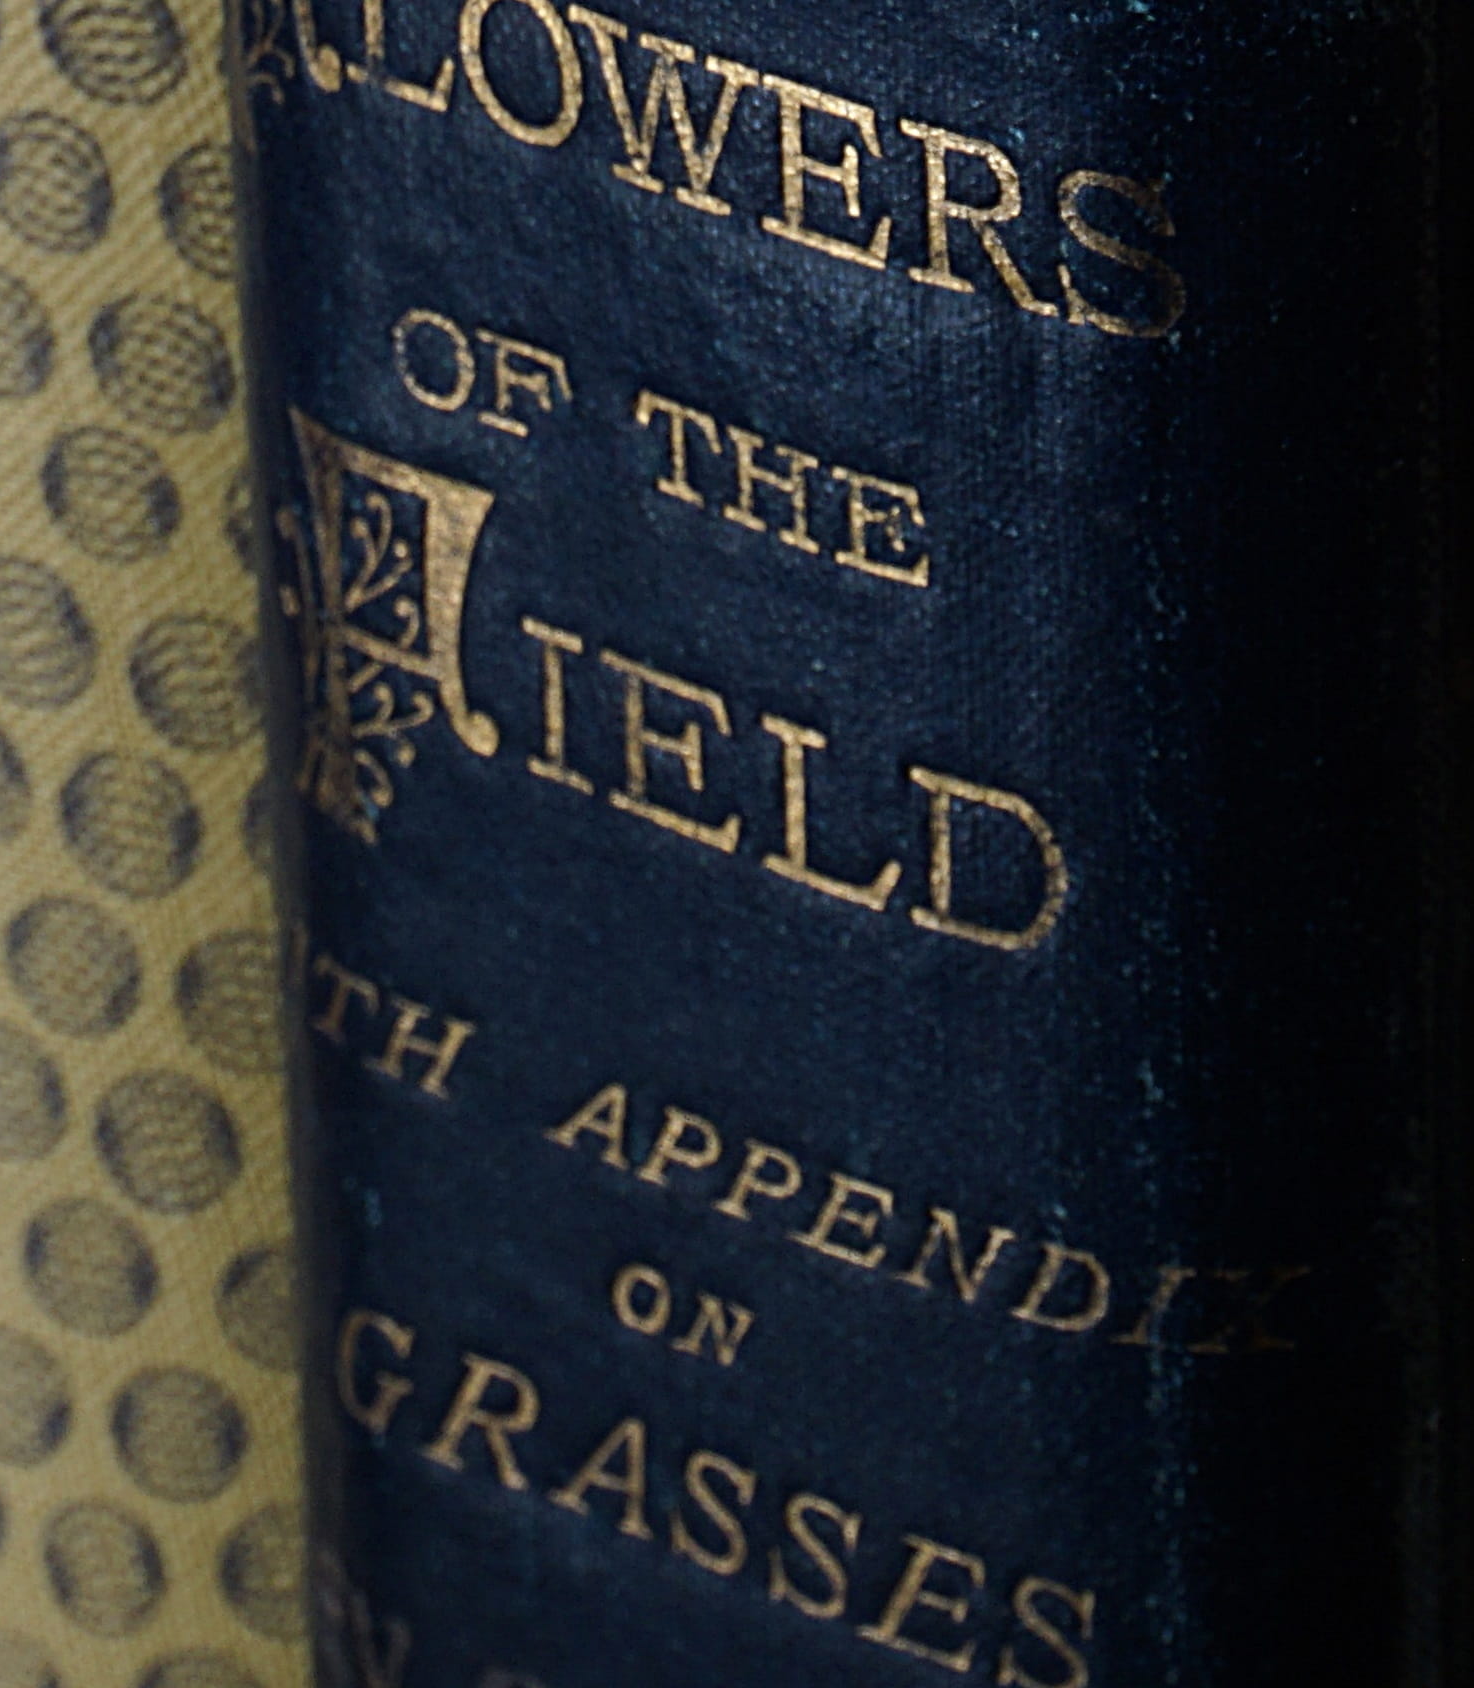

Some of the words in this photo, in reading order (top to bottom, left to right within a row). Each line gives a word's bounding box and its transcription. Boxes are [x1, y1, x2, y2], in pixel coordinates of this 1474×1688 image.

[390, 307, 574, 439] OF
[631, 386, 930, 589] THE
[276, 405, 1068, 953] FIELD
[540, 1080, 1315, 1356] APPENDIX
[608, 1261, 757, 1369] ON
[334, 1306, 1099, 1688] GRASSES
